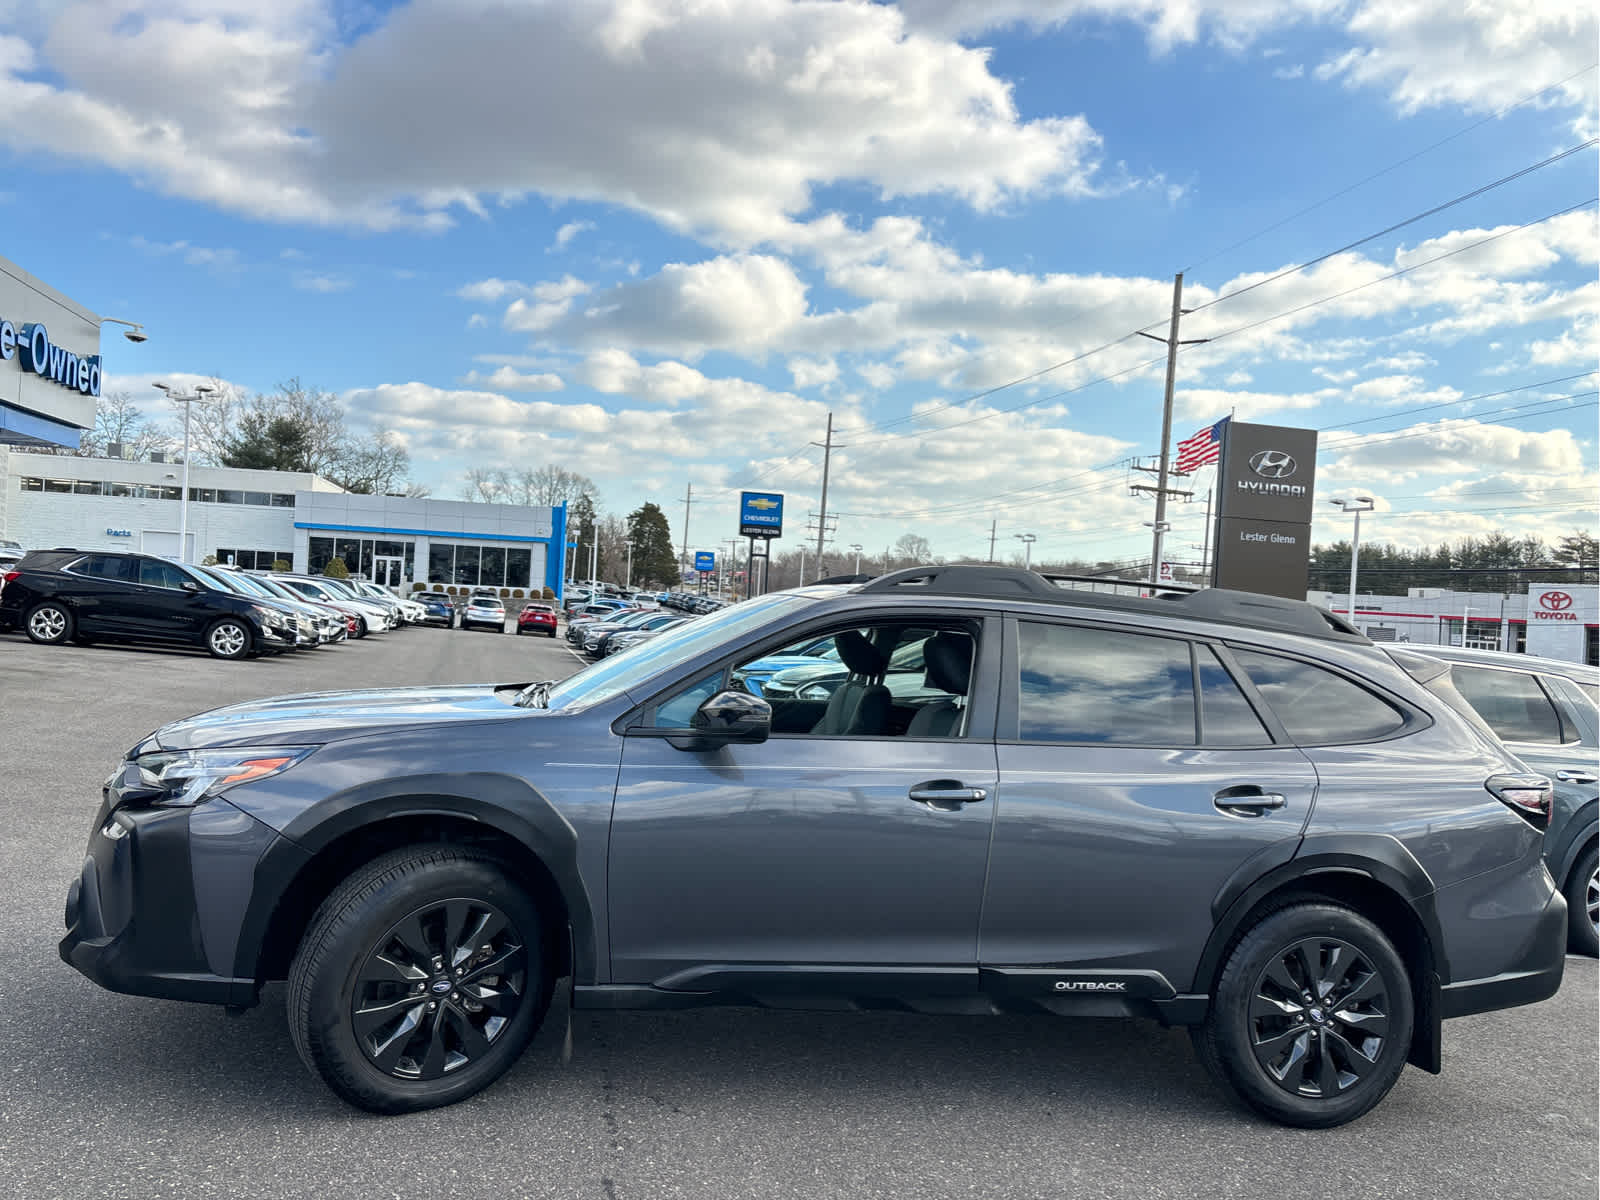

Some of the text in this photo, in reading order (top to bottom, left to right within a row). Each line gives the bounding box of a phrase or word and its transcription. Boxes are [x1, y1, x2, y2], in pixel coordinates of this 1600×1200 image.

[0, 320, 102, 397] e-Owned
[1238, 481, 1306, 497] HYUNDAI
[744, 514, 779, 522] CHEVROLET
[1240, 531, 1296, 544] Lester Glenn
[1534, 611, 1577, 621] TOYOTA
[1055, 981, 1125, 990] OUTBACK
